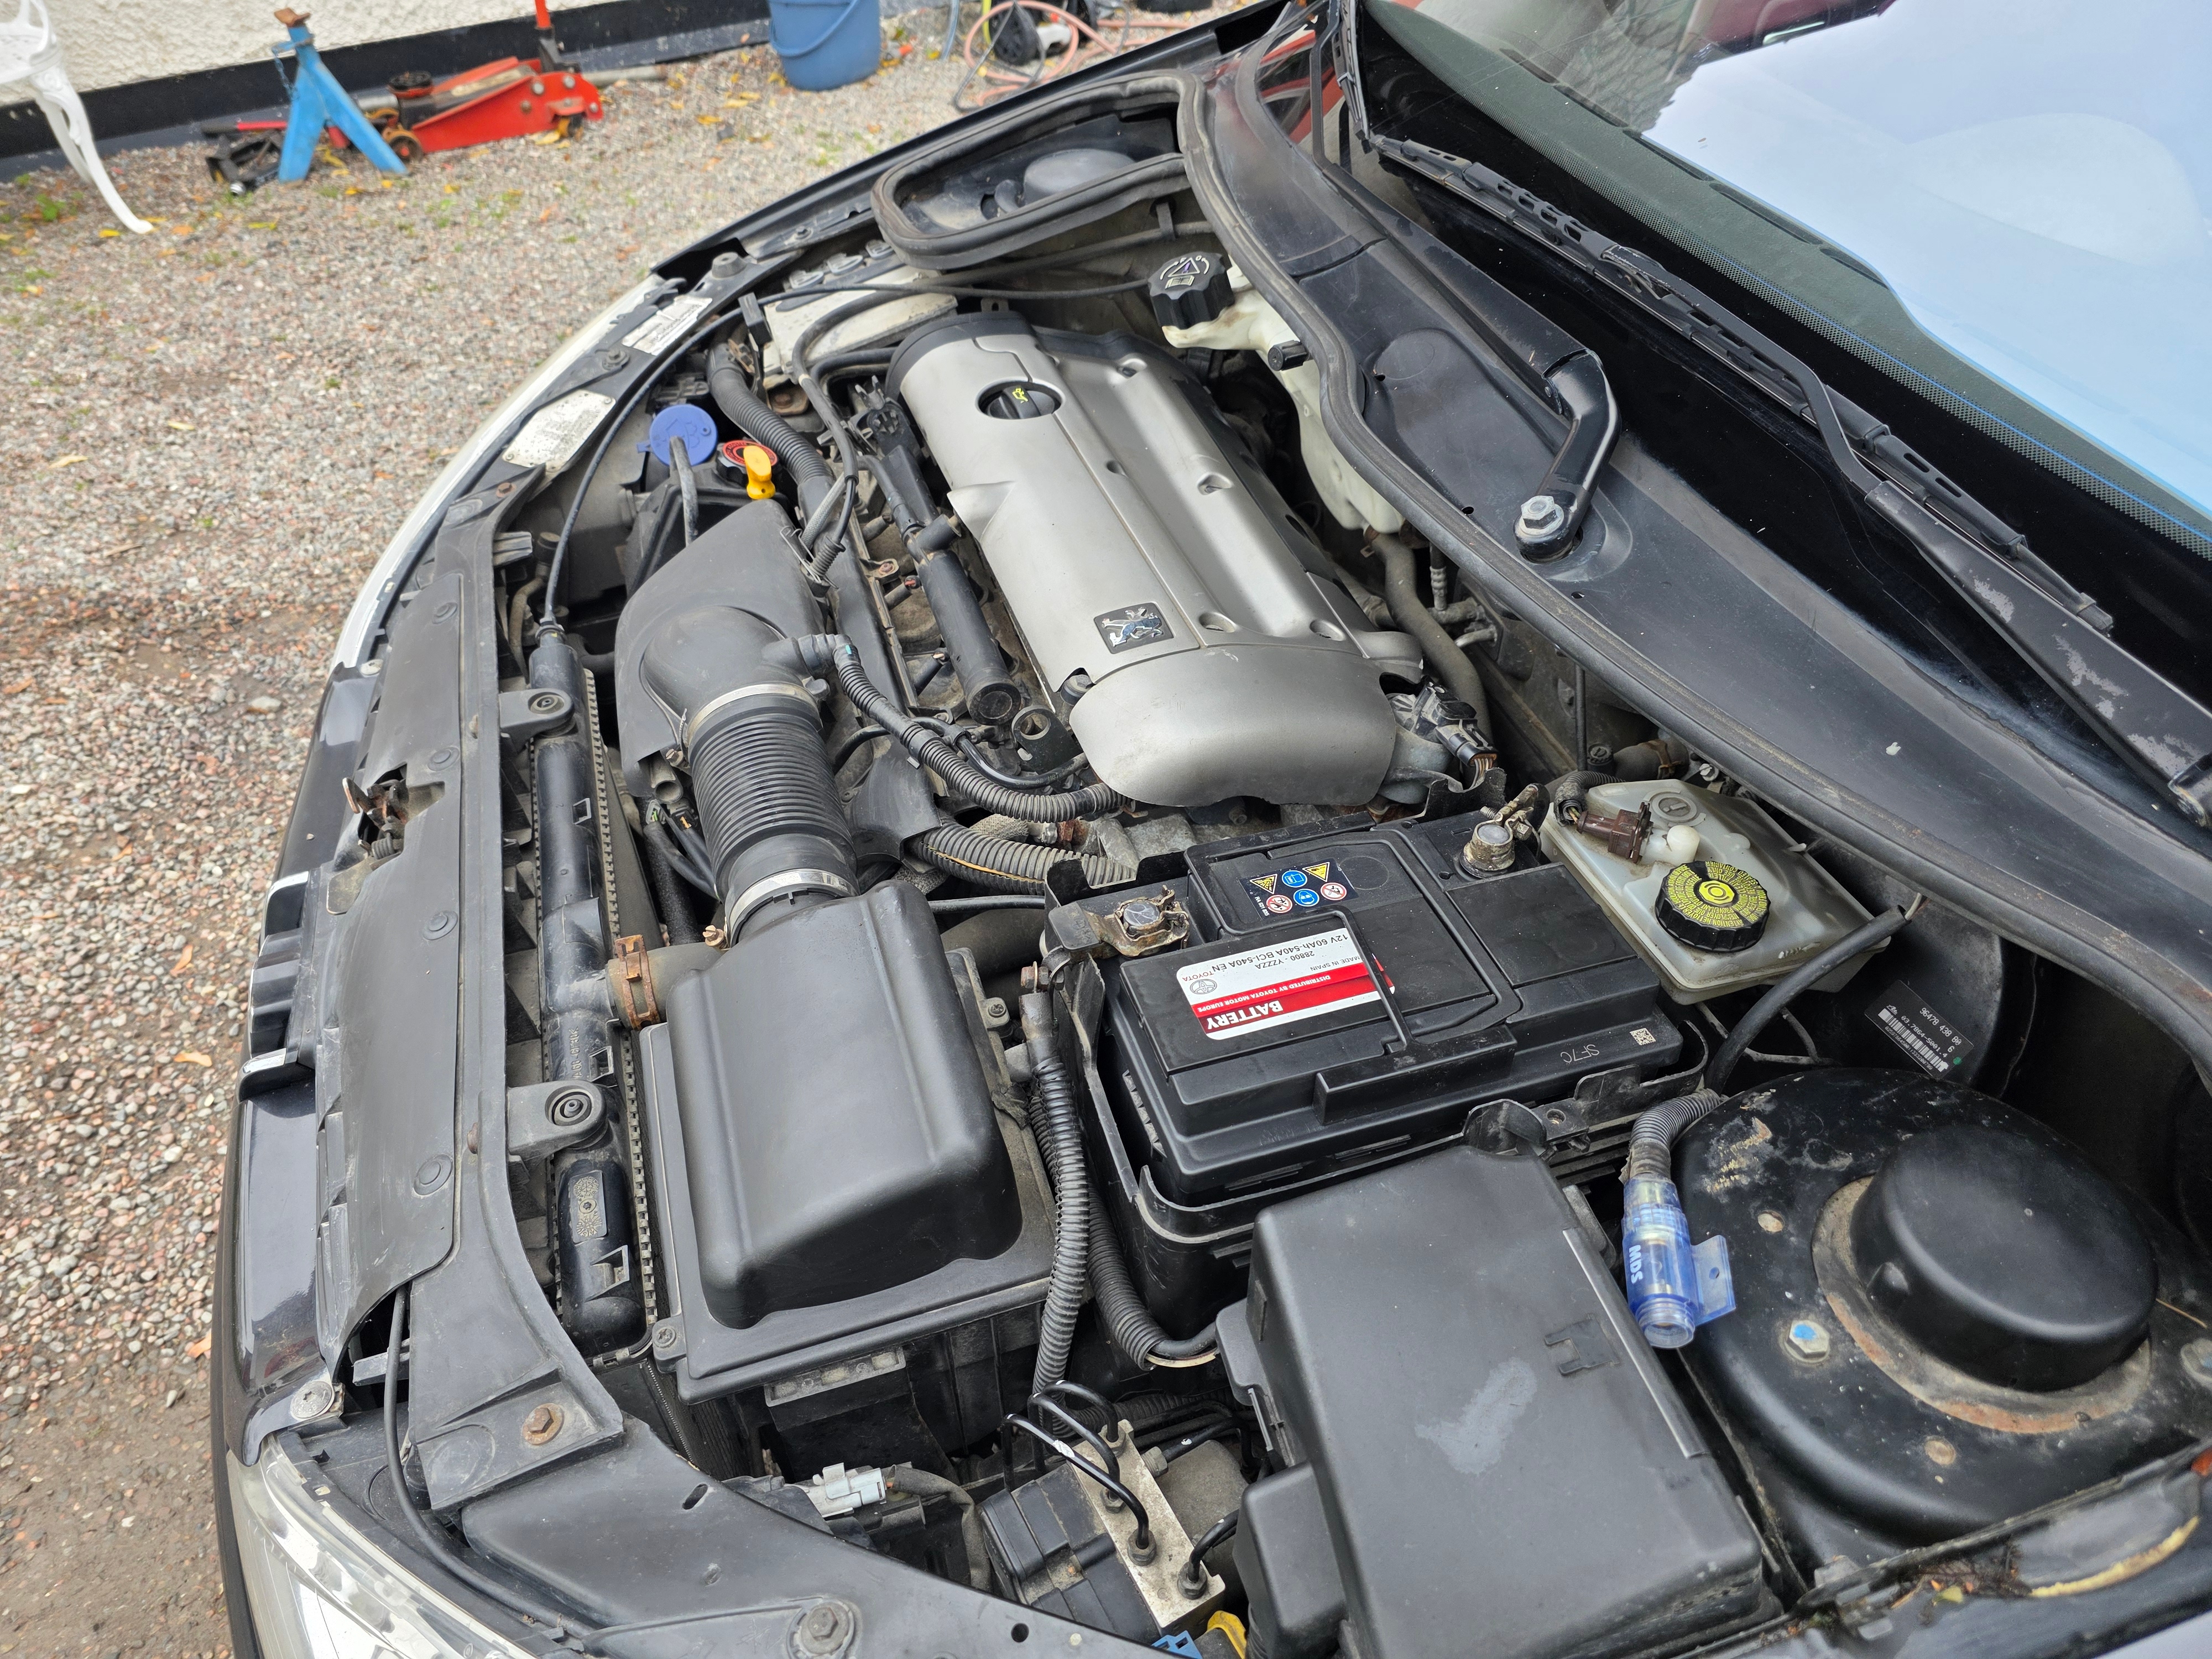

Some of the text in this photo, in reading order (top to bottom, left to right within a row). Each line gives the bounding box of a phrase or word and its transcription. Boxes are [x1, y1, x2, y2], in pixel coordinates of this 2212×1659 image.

[1705, 862, 1738, 873] CONTAINER
[1708, 873, 1731, 882] FILLER
[1737, 870, 1759, 885] SEALED
[1693, 907, 1706, 915] QUE
[1700, 903, 1735, 914] PROVENANT
[1682, 907, 1711, 924] NETTOYER
[1212, 934, 1348, 972] 12V 60Ah-540A BCI-540A EN
[1290, 951, 1315, 961] 28800
[1255, 958, 1284, 969] YZZZA
[1340, 956, 1360, 964] MADE
[1310, 963, 1331, 971] SPAIN
[1182, 971, 1214, 982] TOYOTA
[1288, 975, 1331, 989] DISTRIBUTED
[1250, 989, 1278, 999] TOYOTA
[1224, 995, 1250, 1005] MOTOR
[1197, 1001, 1223, 1013] EUROPE
[1207, 1000, 1284, 1030] BATTERY
[1939, 1025, 1952, 1037] 438
[1629, 1244, 1643, 1284] MDS
